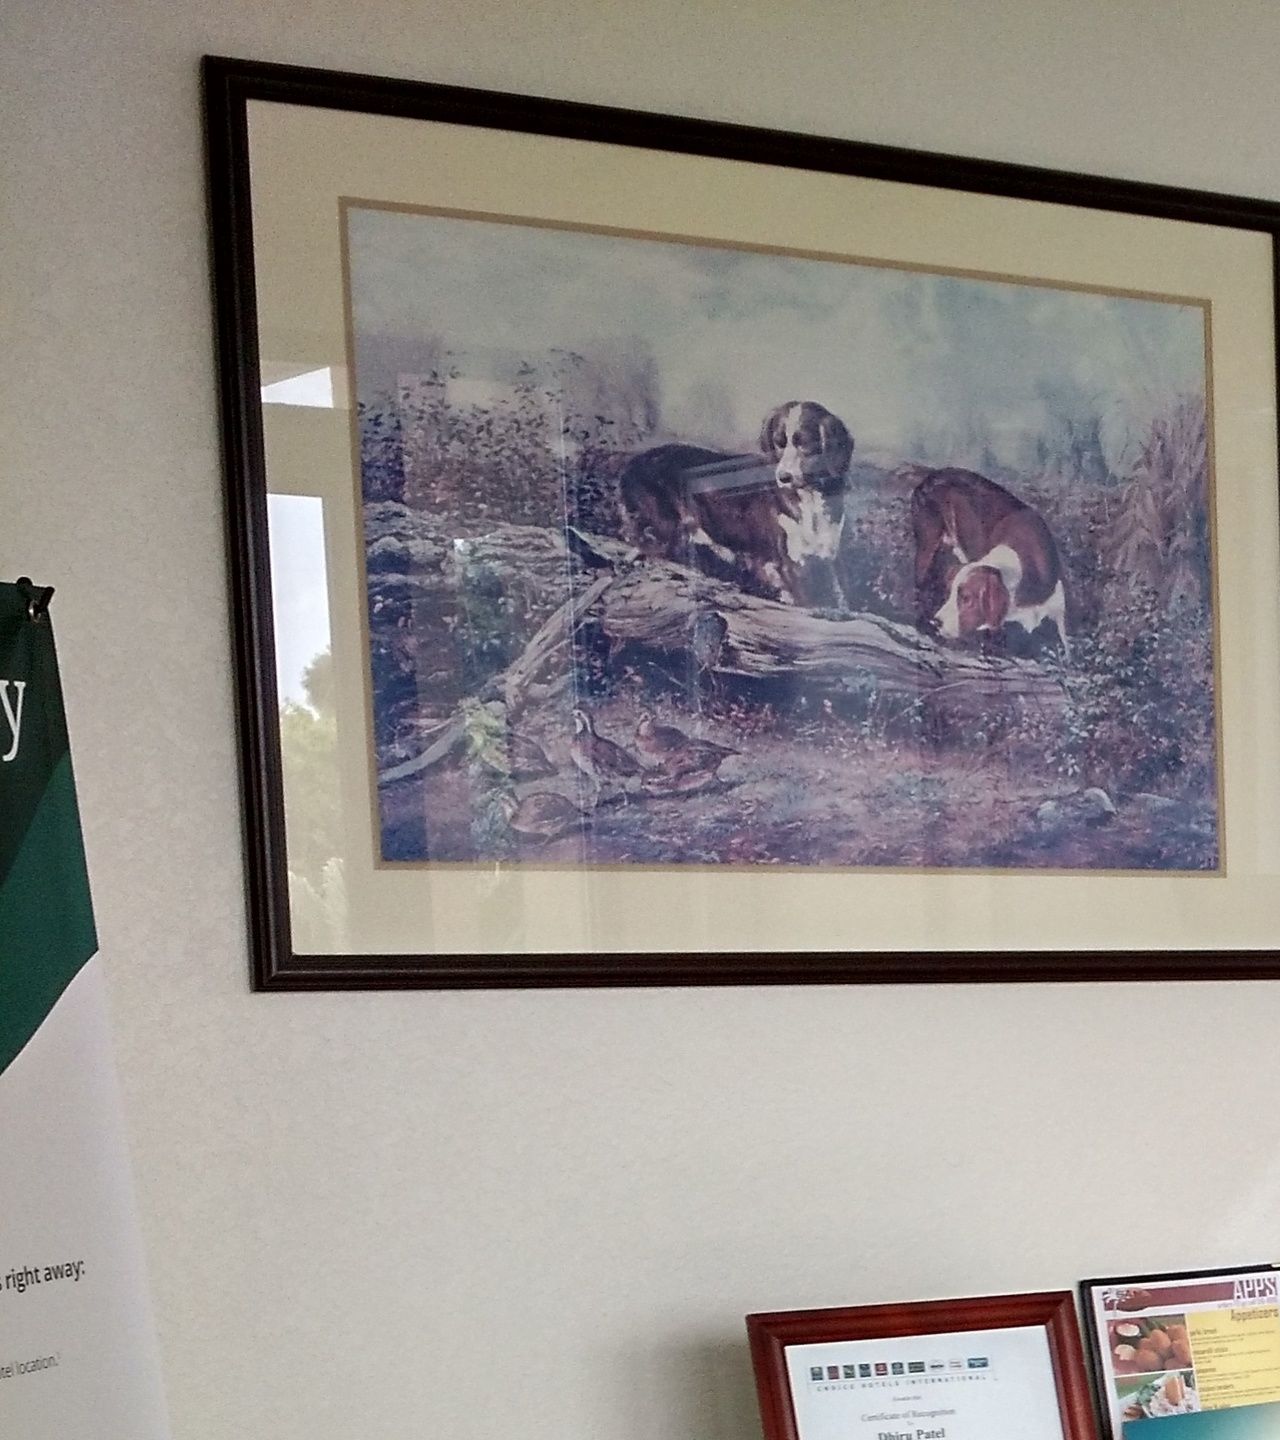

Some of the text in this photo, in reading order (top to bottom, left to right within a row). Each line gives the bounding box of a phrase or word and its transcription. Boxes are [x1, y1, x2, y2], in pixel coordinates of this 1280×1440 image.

[5, 1260, 86, 1293] right away:
[1232, 1277, 1278, 1300] APPS
[816, 1375, 987, 1392] CHOICE HOTELS INTERNATIONAL
[861, 1411, 900, 1423] Certificate
[916, 1427, 946, 1440] Patel
